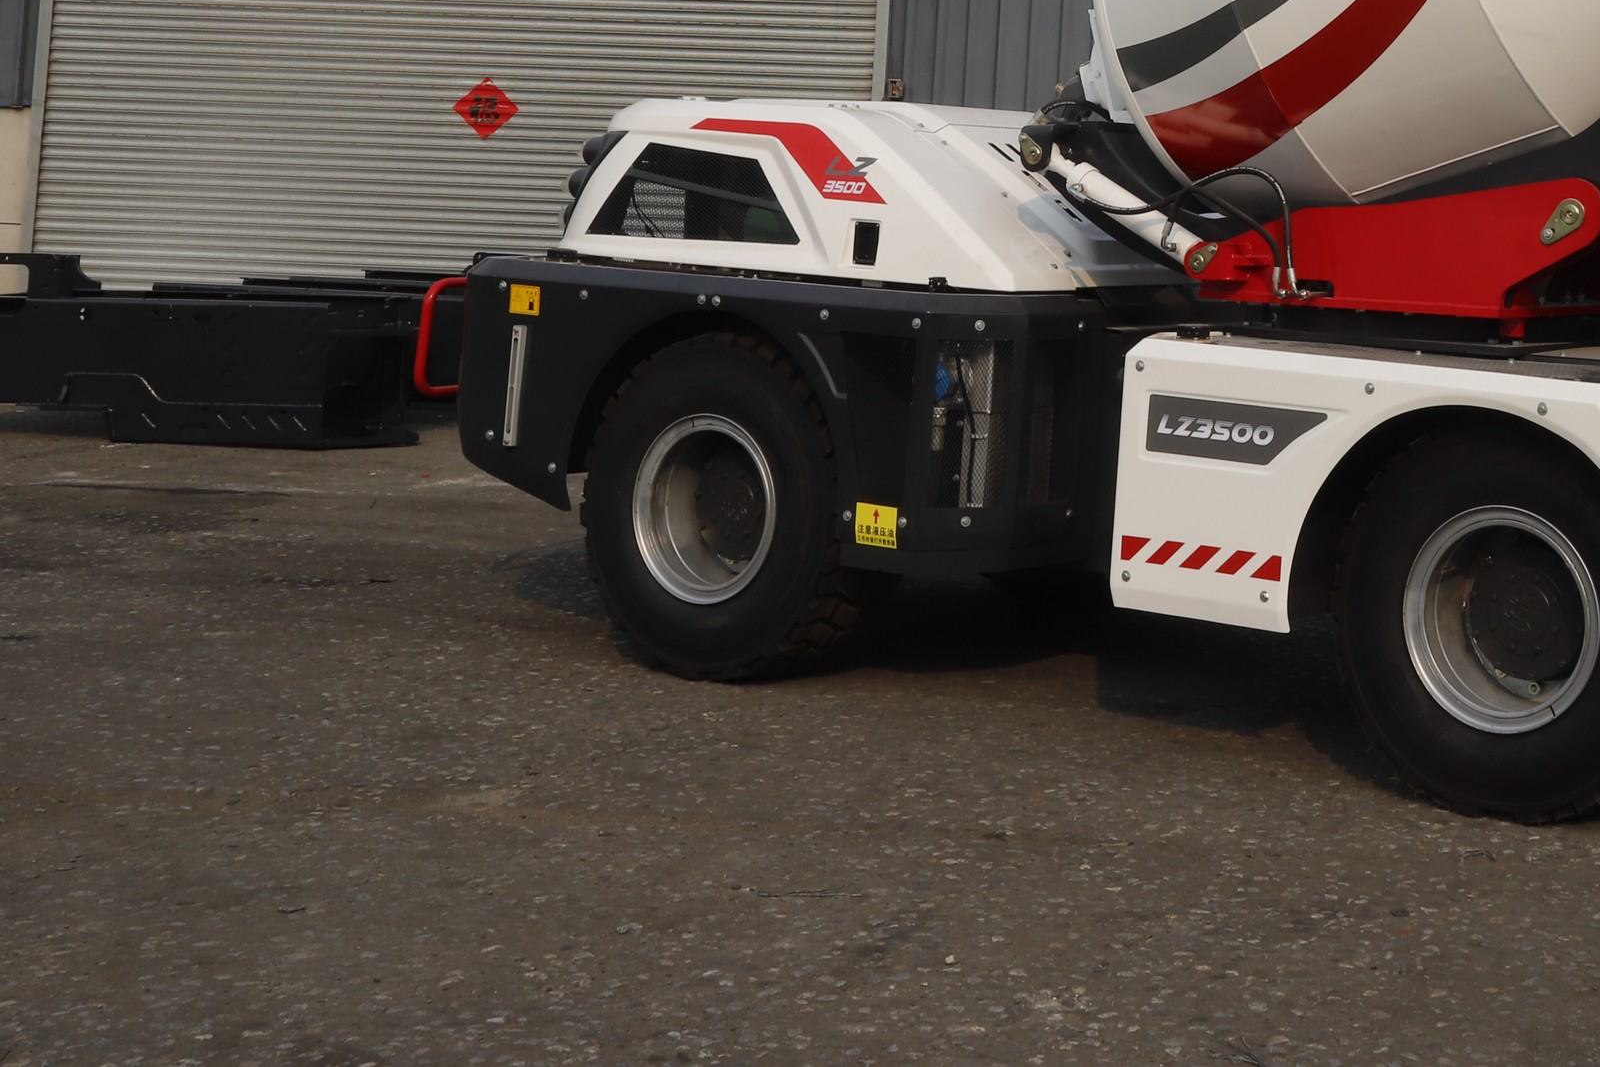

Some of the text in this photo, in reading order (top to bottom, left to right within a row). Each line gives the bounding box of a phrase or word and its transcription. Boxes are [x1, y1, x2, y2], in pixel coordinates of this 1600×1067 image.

[824, 156, 878, 177] LZ
[822, 180, 867, 194] 3500
[1156, 414, 1275, 446] LZ3500
